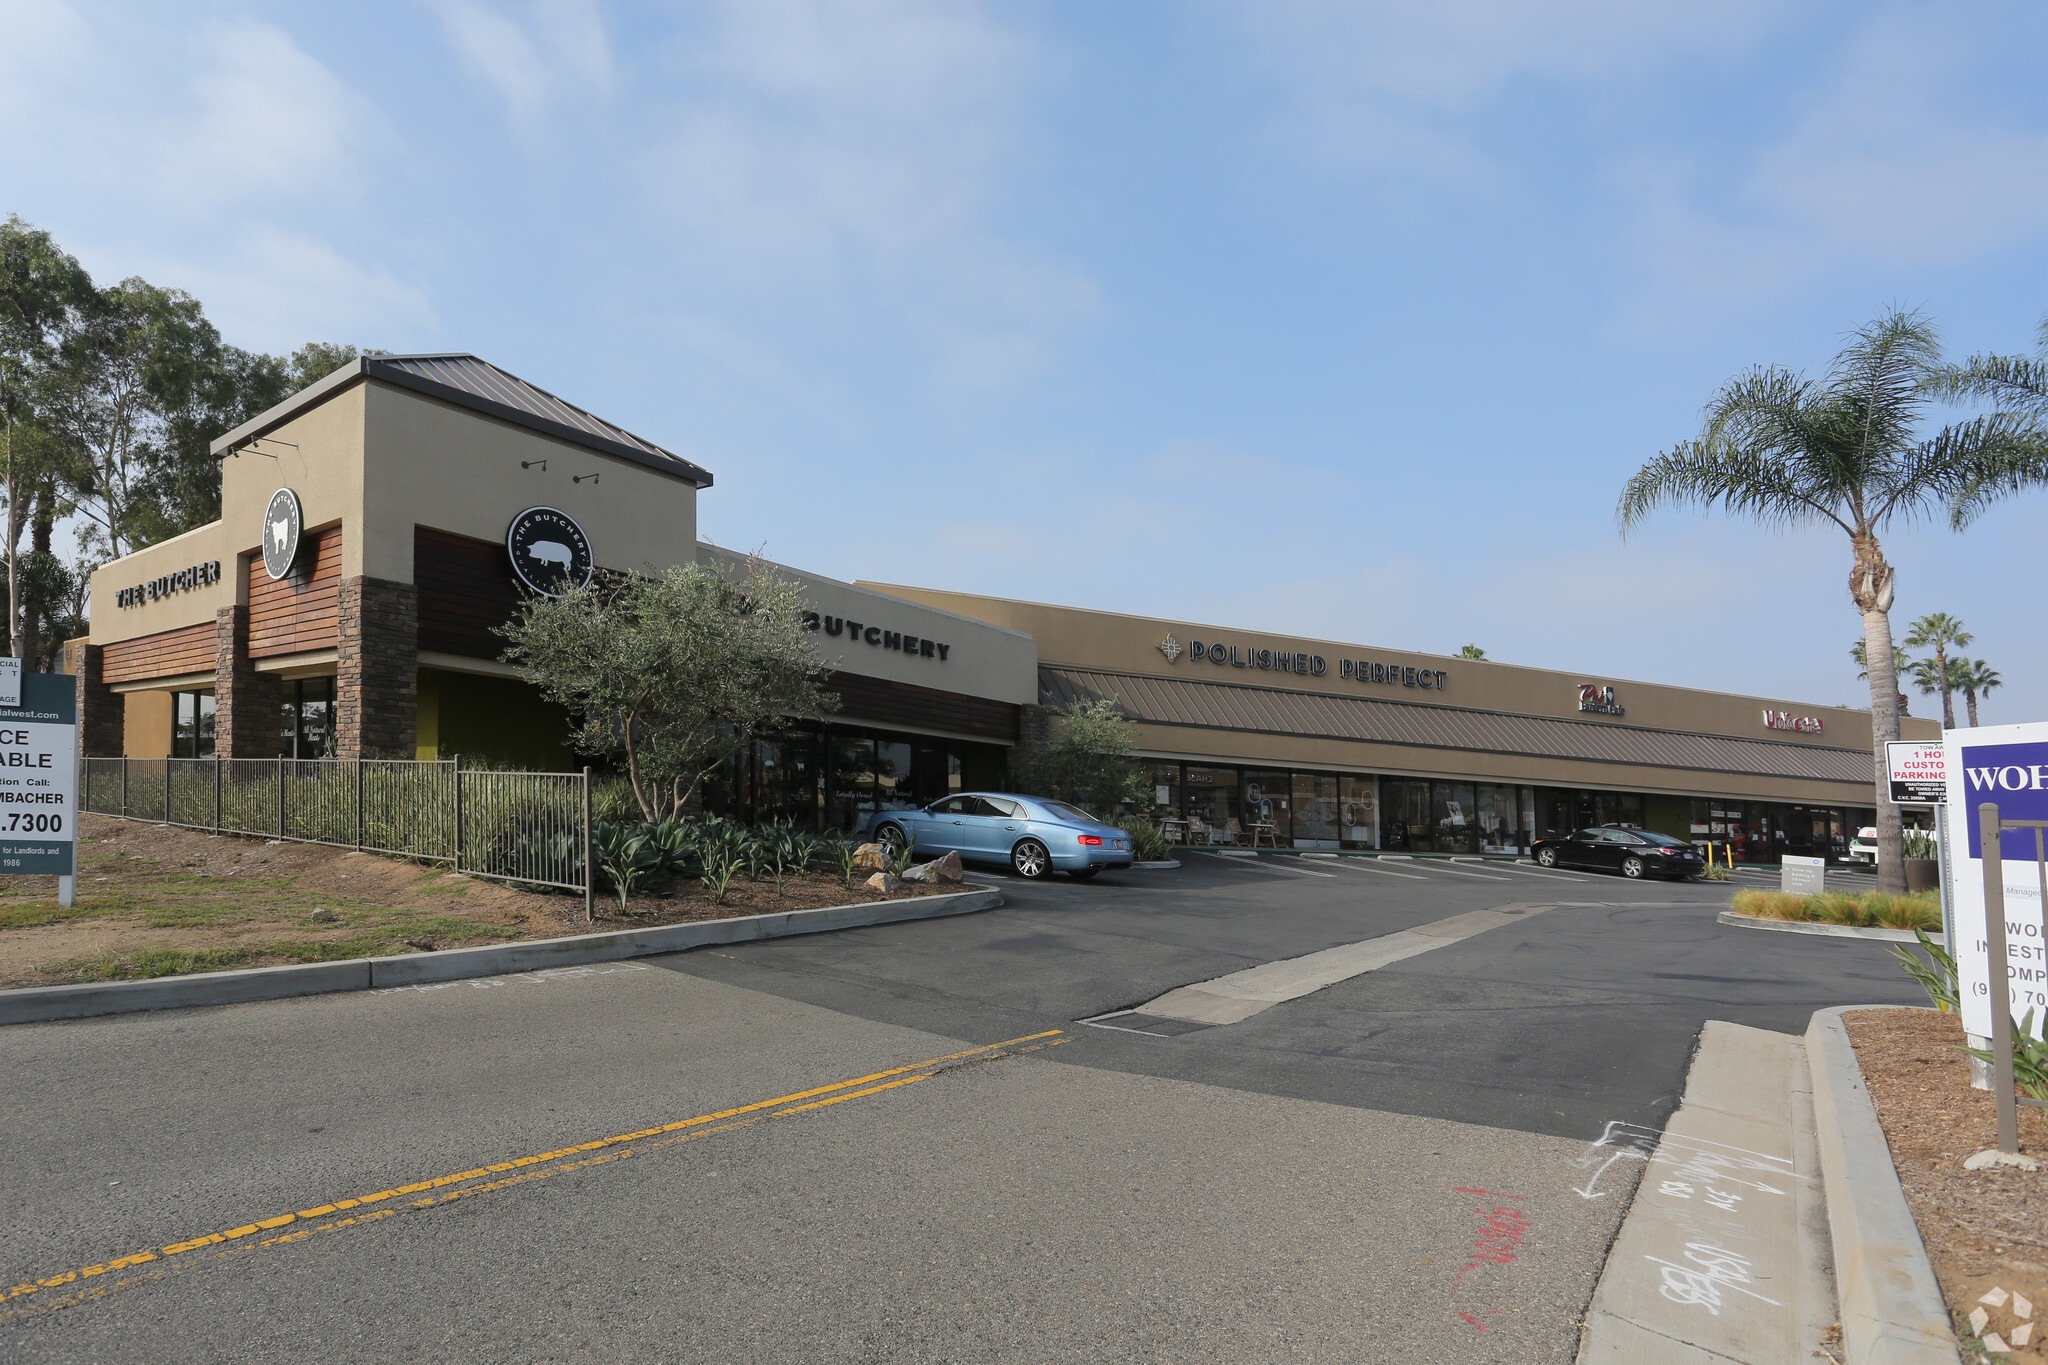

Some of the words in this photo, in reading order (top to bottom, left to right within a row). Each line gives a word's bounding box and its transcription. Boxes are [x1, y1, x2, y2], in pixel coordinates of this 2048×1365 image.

[515, 520, 531, 541] THE
[534, 514, 587, 558] BUTCHERY
[115, 584, 146, 609] THE
[147, 560, 221, 600] BUTCHER
[802, 610, 951, 661] BUTCHERY
[1190, 640, 1328, 676] POLISHED
[1340, 658, 1448, 691] PERFECT
[0, 729, 29, 746] CE
[1904, 761, 1945, 769] CUSTO
[27, 778, 50, 786] Call:
[1894, 771, 1946, 779] PARKING
[14, 847, 45, 855] Landlords
[3, 859, 21, 867] 1986
[2005, 921, 2043, 938] WO
